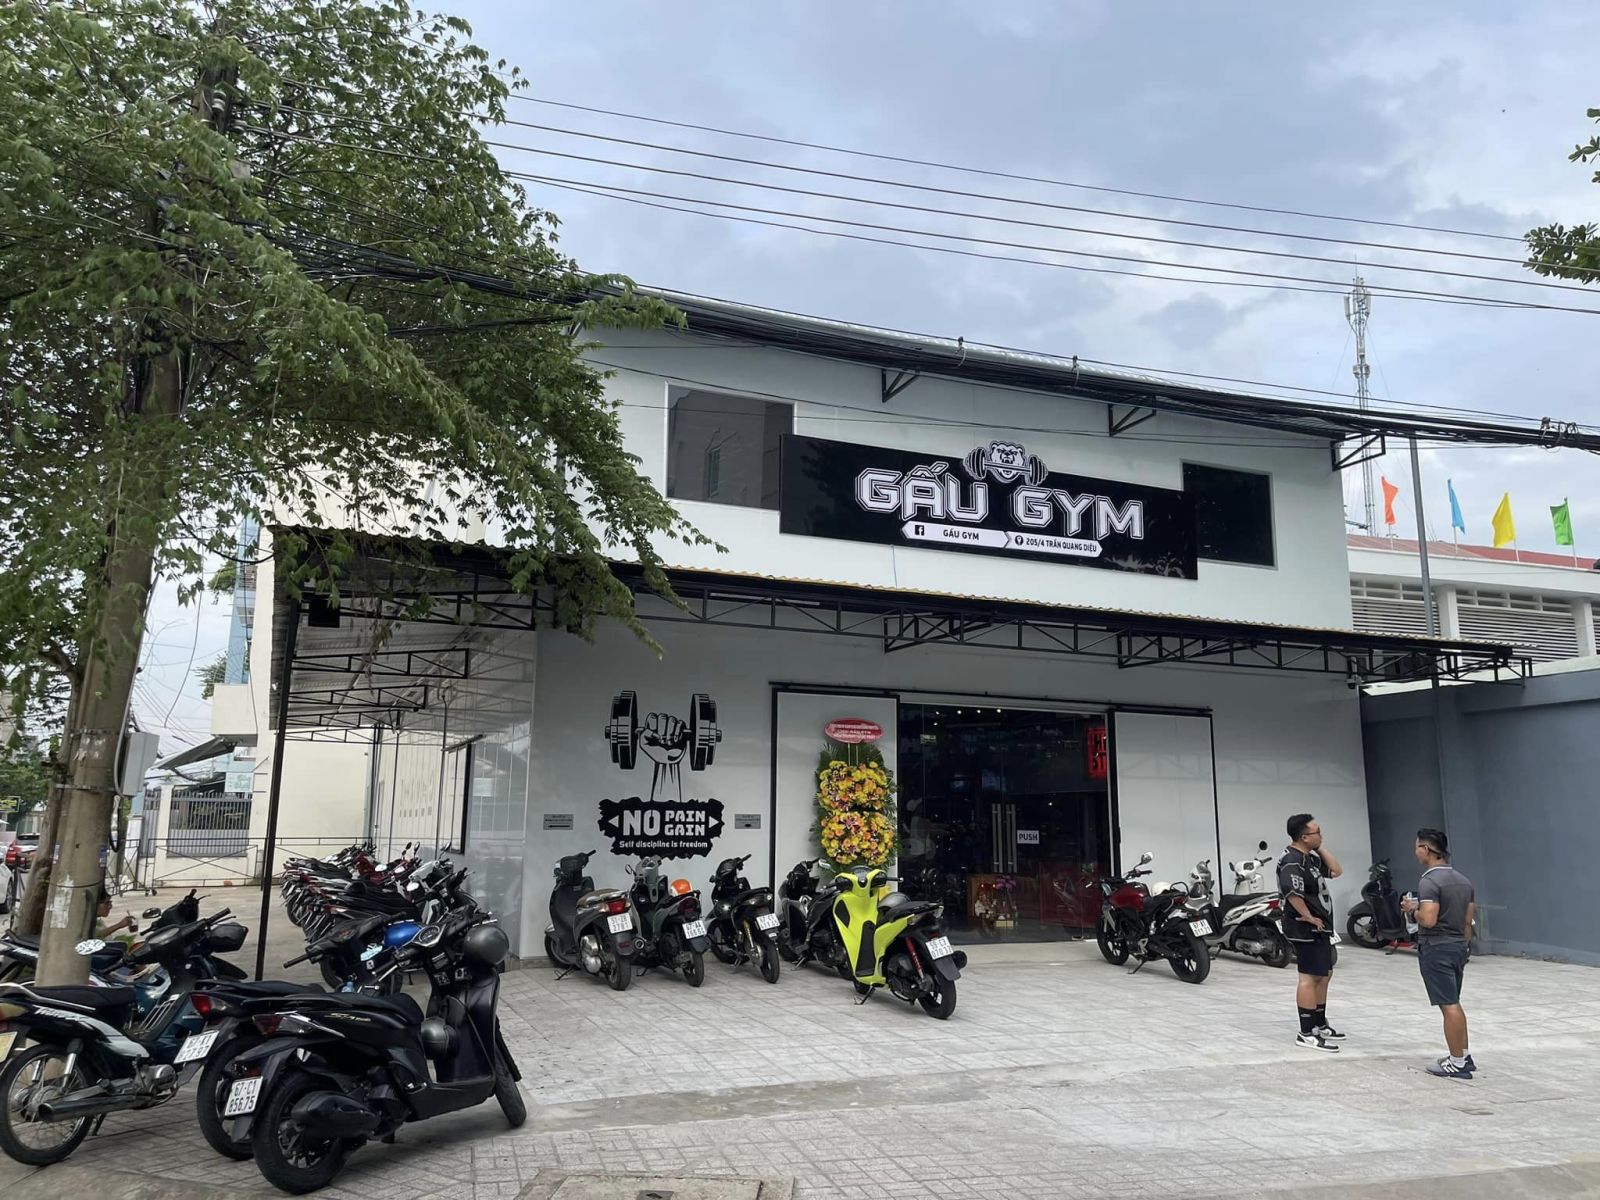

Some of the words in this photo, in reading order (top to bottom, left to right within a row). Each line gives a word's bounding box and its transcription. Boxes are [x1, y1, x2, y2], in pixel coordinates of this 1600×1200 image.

[855, 462, 988, 522] GẤU
[1011, 485, 1143, 540] GYM
[943, 528, 960, 539] GẤU
[962, 531, 979, 540] GYM
[1062, 542, 1082, 551] QUANG
[665, 810, 706, 822] PAIN
[623, 810, 661, 836] NO
[664, 824, 706, 836] GAIN
[1019, 833, 1038, 841] PUSH
[635, 841, 670, 849] discipline
